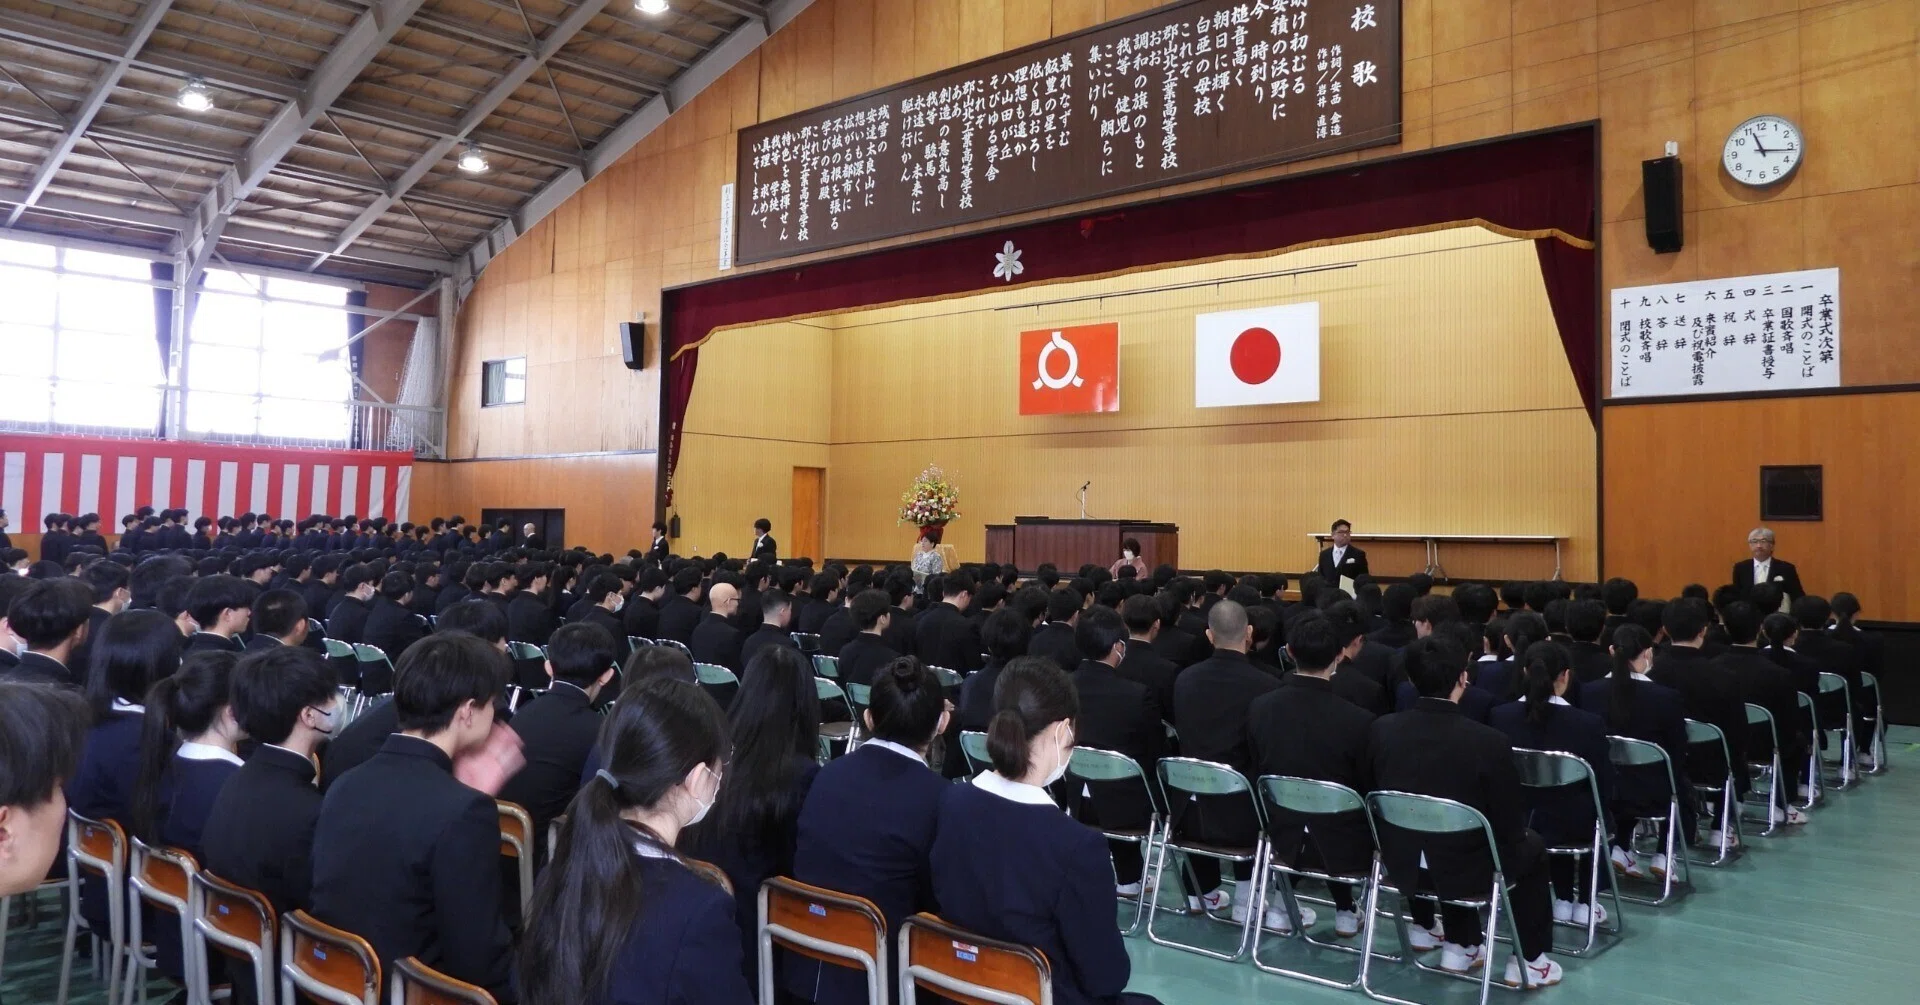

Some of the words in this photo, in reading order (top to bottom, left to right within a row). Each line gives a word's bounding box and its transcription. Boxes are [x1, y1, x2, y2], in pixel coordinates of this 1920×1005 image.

[1116, 37, 1132, 76] 我等
[1149, 30, 1162, 67] おお
[1179, 22, 1194, 79] これぞ
[1193, 16, 1212, 117] 白亜の母校
[1212, 10, 1231, 112] 朝日に輝く
[1231, 3, 1250, 87] 槌音高く
[1351, 4, 1378, 87] 校歌
[1088, 45, 1103, 122] 集いけり
[1102, 44, 1114, 99] ここに
[1250, 40, 1269, 104] 時到り
[913, 95, 926, 144] 永遠に
[927, 91, 938, 125] 我等
[952, 85, 961, 117] ああ
[975, 80, 986, 129] これぞ
[1000, 73, 1015, 160] 八山田が丘
[1029, 62, 1044, 172] 低く見おろし
[1045, 58, 1059, 149] 飯豊の星を
[1060, 53, 1073, 146] 暮れなずむ
[1114, 95, 1131, 135] 健児
[1132, 31, 1149, 169] 調和の旗のもと
[1161, 23, 1179, 171] 郡山北工業高等学校
[772, 135, 781, 165] 我等
[792, 133, 800, 159] いざ
[811, 126, 820, 170] これぞ
[878, 105, 889, 152] 残雪の
[938, 87, 951, 208] 創造の意気高し
[960, 80, 975, 209] 郡山北工業高等学校
[986, 75, 1000, 181] そびゆる学舎
[1100, 119, 1115, 177] 朗らに
[1735, 138, 1745, 146] 10
[1744, 128, 1753, 136] 11
[1757, 122, 1767, 131] 12
[761, 137, 771, 167] 真理
[830, 118, 843, 230] 不抜の根を張る
[843, 114, 855, 211] 拡がる都市に
[854, 112, 865, 192] 想いも深く
[865, 108, 877, 206] 安達太良山に
[752, 144, 761, 216] いそしまん
[780, 131, 791, 240] 特色を発揮せん
[798, 126, 812, 241] 郡山北工業高等学校
[912, 163, 923, 214] 未来に
[1620, 299, 1631, 309] 十
[1639, 296, 1651, 307] 九
[1656, 295, 1669, 305] 八
[1675, 293, 1686, 303] 七
[1704, 290, 1716, 301] 六
[1723, 289, 1735, 300] 五
[1743, 288, 1756, 296] 四
[1762, 285, 1774, 296] 三
[1780, 285, 1794, 294] 二
[1639, 317, 1652, 363] 校歌斉唱
[1656, 317, 1668, 350] 答辞
[1674, 315, 1687, 349] 送辞
[1692, 316, 1705, 386] 及び祝電披露
[1704, 312, 1717, 359] 来賓紹介
[1723, 312, 1736, 346] 祝辞
[1743, 309, 1757, 345] 式辞
[1761, 308, 1775, 379] 卒業証書授与
[1780, 307, 1795, 354] 国歌斉唱
[1800, 305, 1815, 378] 開式のことば
[1818, 294, 1834, 364] 卒業式次第
[1619, 320, 1632, 387] 閉式のことば
